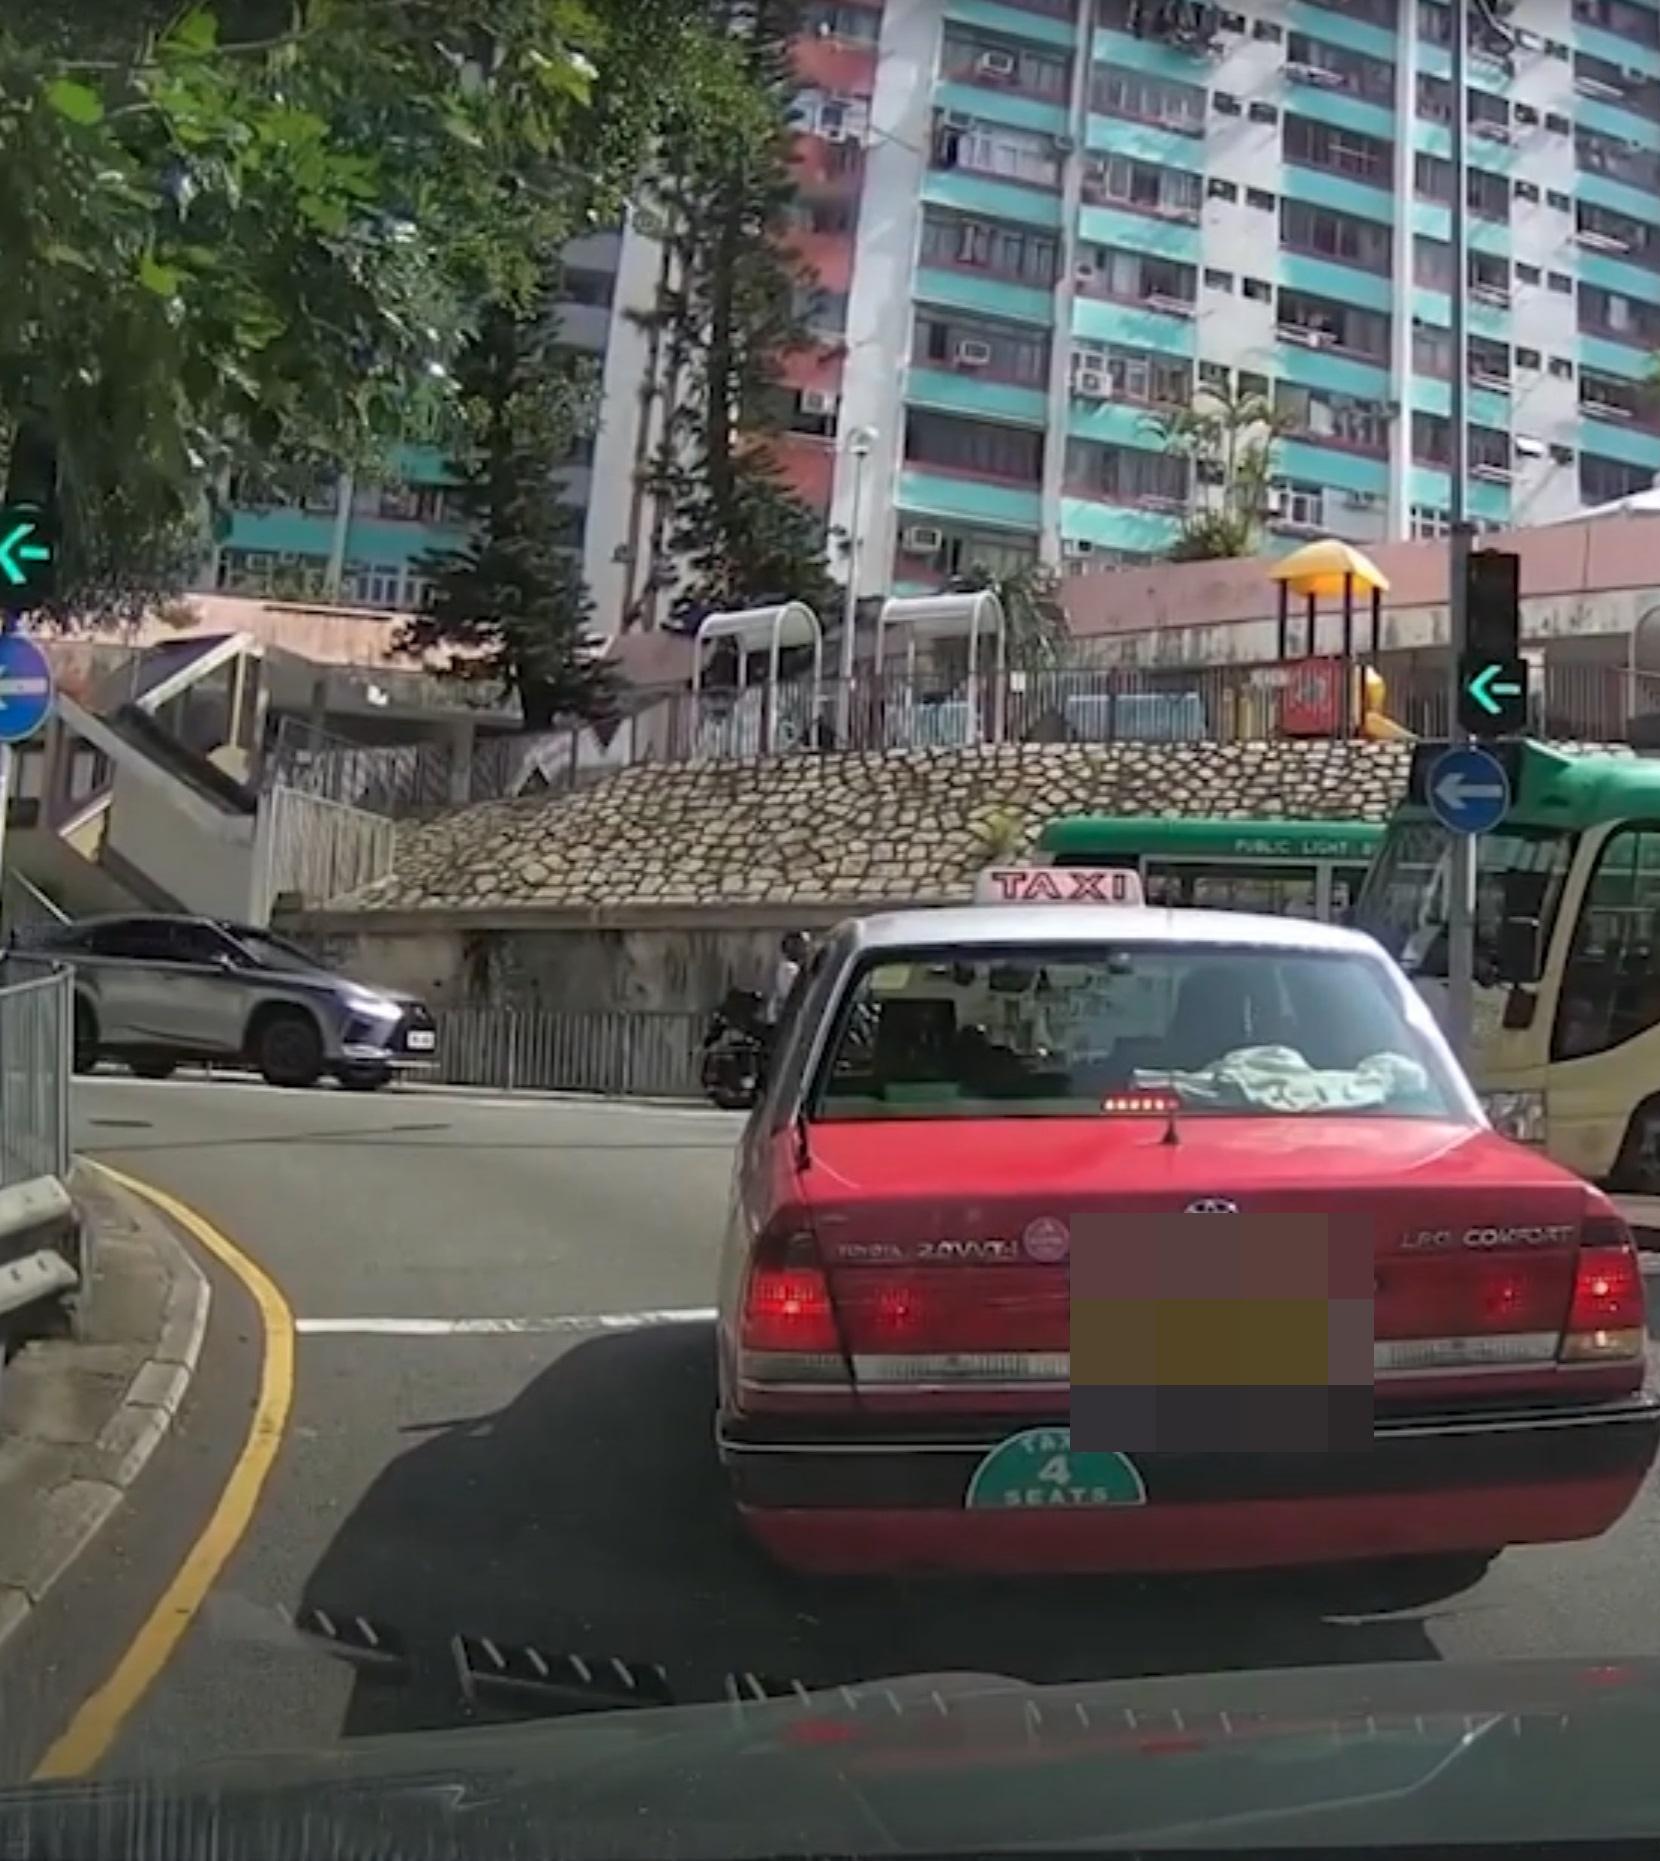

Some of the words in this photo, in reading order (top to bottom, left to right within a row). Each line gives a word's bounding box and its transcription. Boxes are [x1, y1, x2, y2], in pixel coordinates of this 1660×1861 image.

[1235, 839, 1291, 854] PUBLIC
[1303, 840, 1348, 855] LIGHT
[991, 872, 1126, 900] TAXI
[1463, 1225, 1575, 1247] COMFORT
[1037, 1455, 1071, 1485] 4
[1004, 1486, 1108, 1506] SEATS
